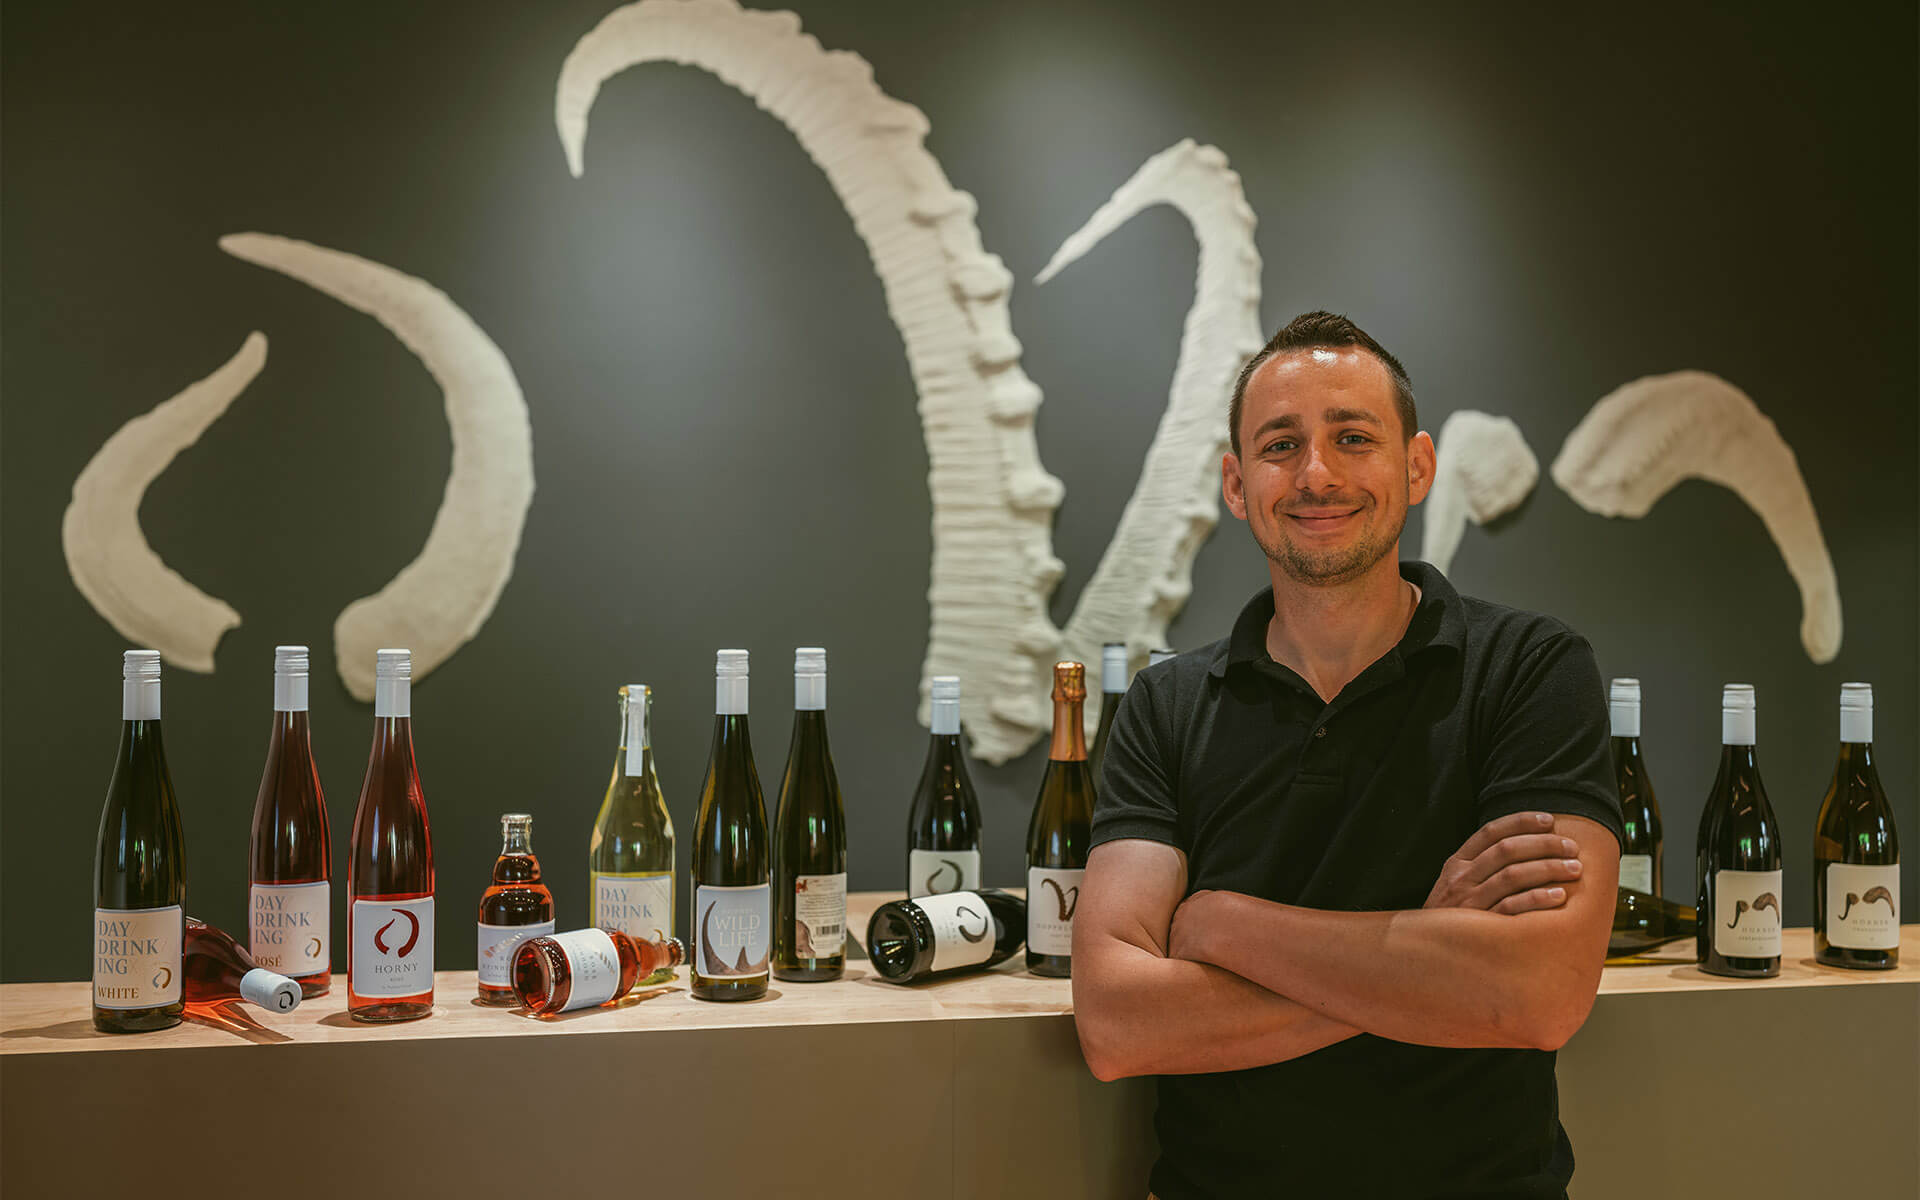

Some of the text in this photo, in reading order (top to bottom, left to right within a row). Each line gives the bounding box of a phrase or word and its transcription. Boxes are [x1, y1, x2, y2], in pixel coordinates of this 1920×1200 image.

[255, 895, 286, 910] DAY
[601, 888, 629, 902] DAY
[600, 904, 653, 919] DRINK
[255, 912, 312, 928] DRINK
[714, 914, 761, 931] WILD
[98, 920, 131, 937] DAY
[255, 930, 283, 945] ING
[719, 930, 758, 948] LIFE
[97, 939, 160, 956] DRINK
[98, 958, 129, 975] ING
[375, 962, 419, 974] HORNY
[98, 986, 140, 999] WHITE
